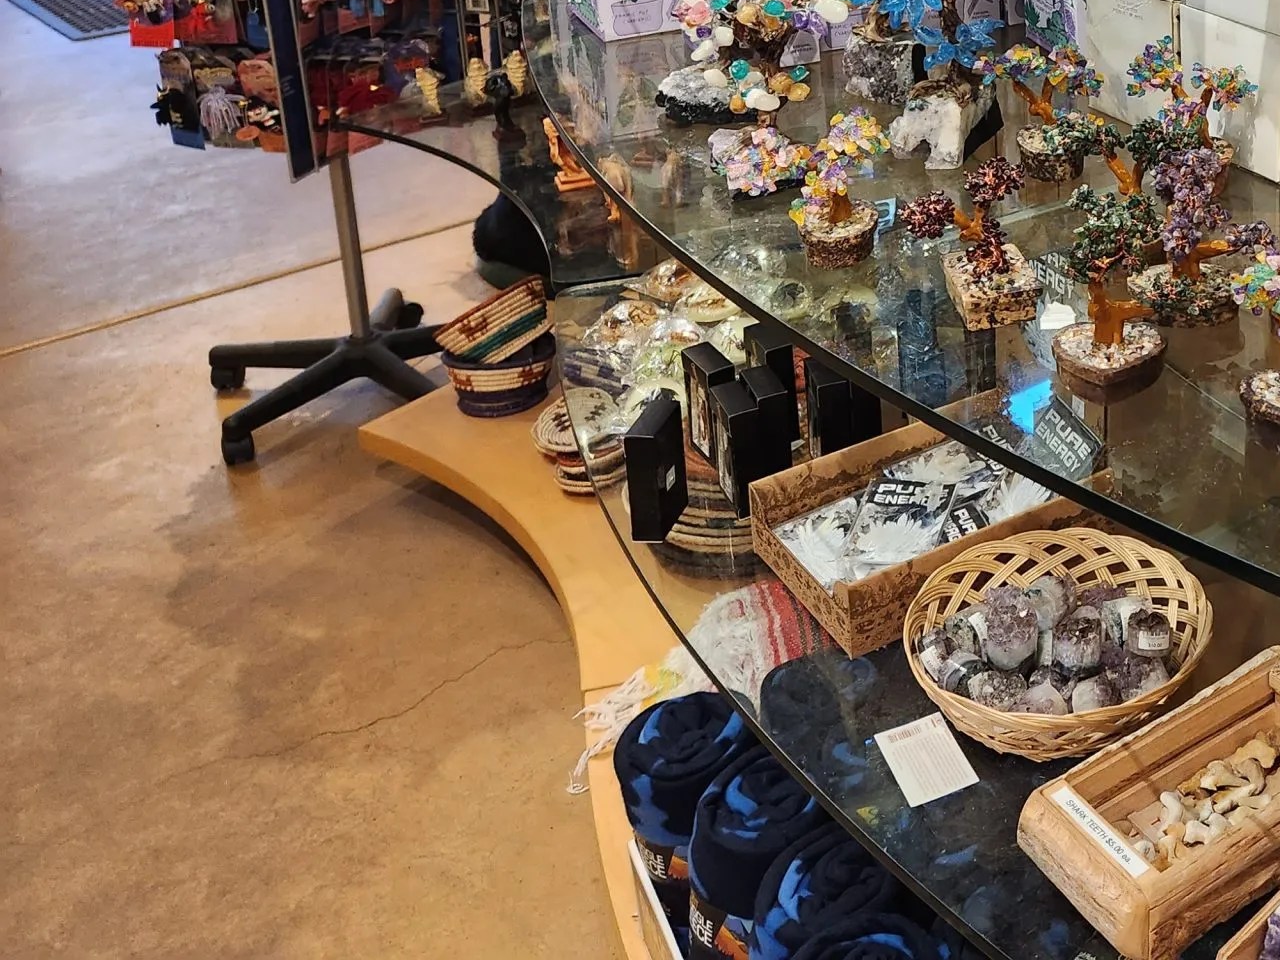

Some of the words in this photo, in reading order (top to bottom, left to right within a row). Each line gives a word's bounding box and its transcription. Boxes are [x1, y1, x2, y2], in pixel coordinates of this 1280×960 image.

[1035, 421, 1083, 474] ENERGY
[1045, 408, 1092, 461] PURE
[1065, 798, 1087, 821] SHARK
[1086, 818, 1108, 840] TEETH
[1104, 836, 1124, 856] $5.00
